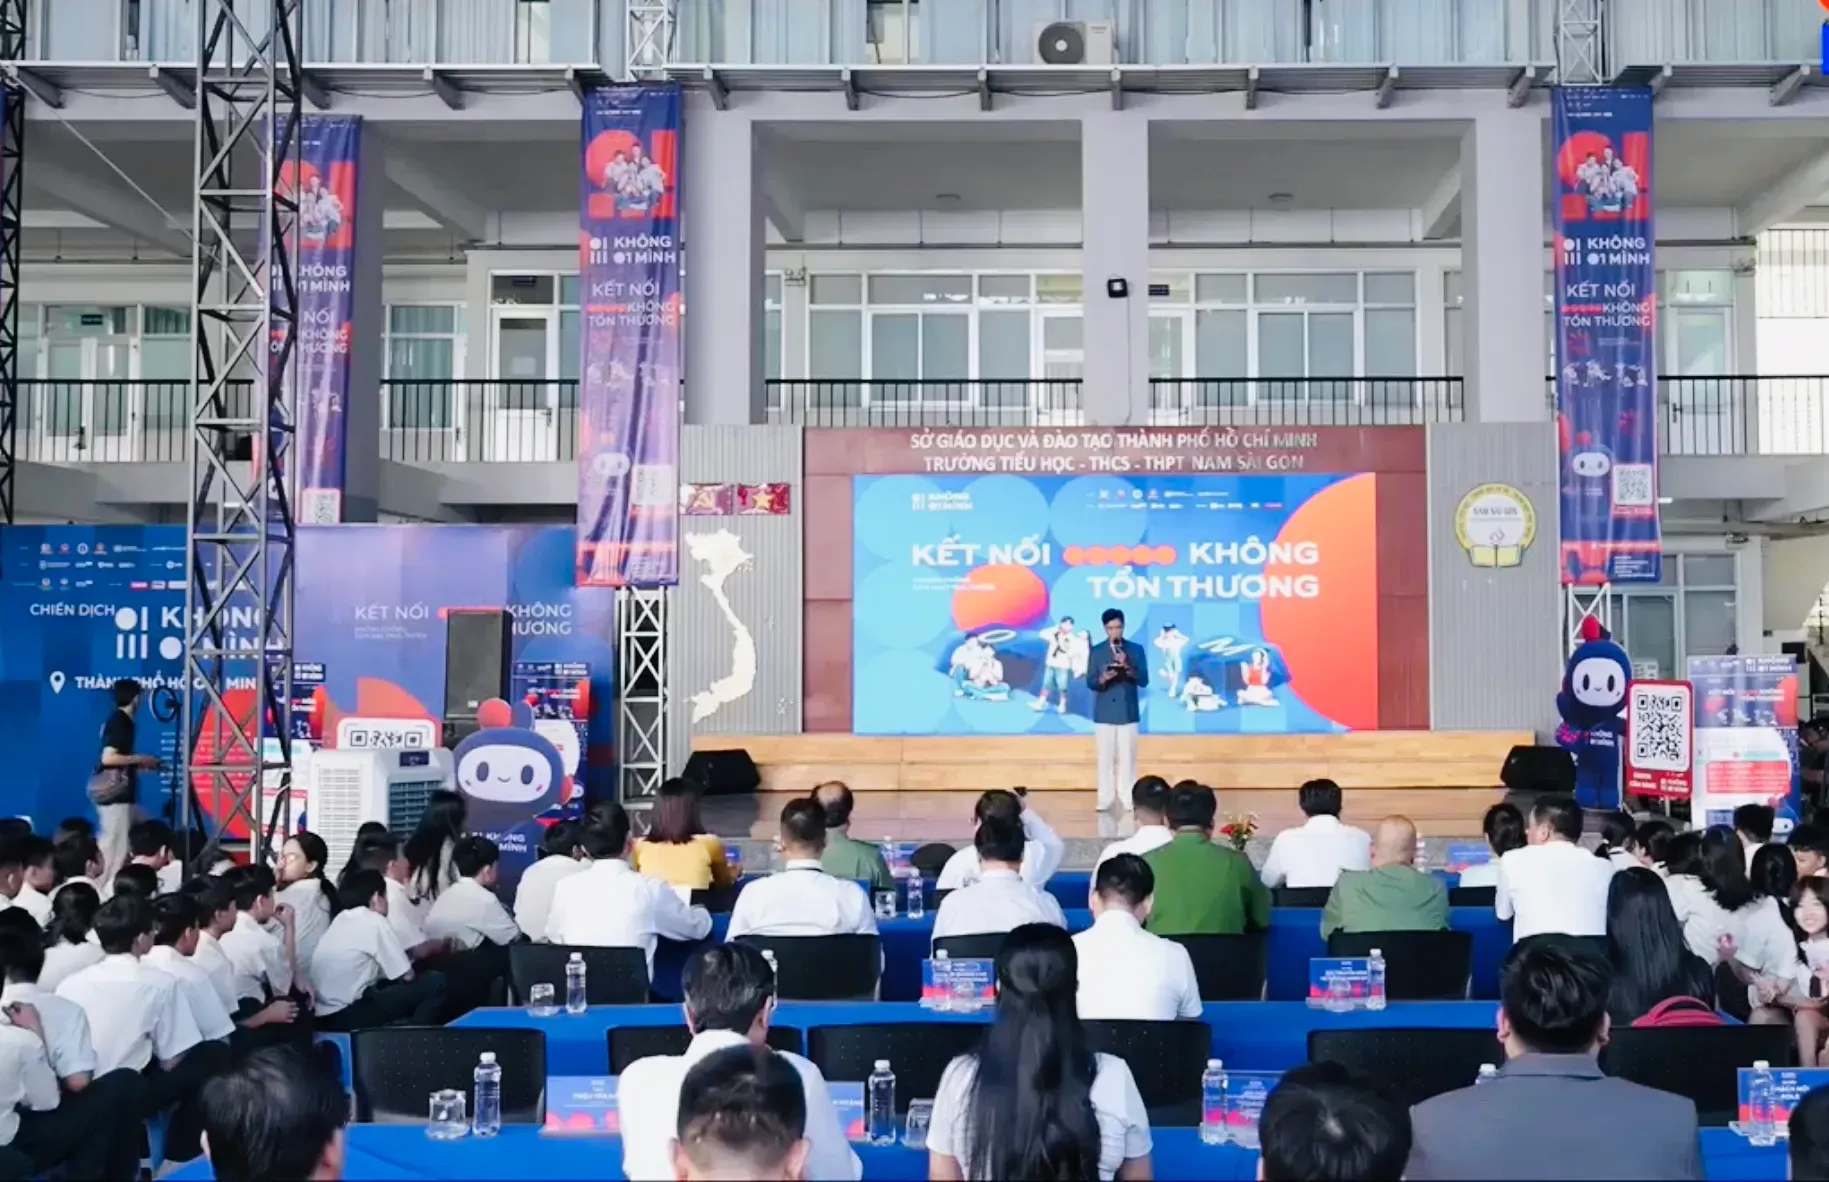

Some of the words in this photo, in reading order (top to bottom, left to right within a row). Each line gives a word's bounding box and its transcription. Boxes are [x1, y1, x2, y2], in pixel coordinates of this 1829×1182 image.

[614, 232, 672, 248] KHÔNG
[1587, 234, 1646, 249] KHÔNG
[634, 250, 676, 263] MÌNH
[1609, 250, 1651, 265] MÌNH
[298, 262, 347, 277] HÔNG
[310, 277, 351, 292] MÌNH
[1566, 280, 1600, 298] KẾT
[1604, 278, 1636, 298] NỐI
[627, 300, 674, 312] KHÔNG
[1602, 300, 1651, 313] KHÔNG
[1594, 315, 1651, 327] THƯƠNG
[910, 428, 933, 449] SỞ
[936, 428, 977, 449] GIÁO
[981, 433, 1014, 452] DỤC
[1017, 428, 1039, 449] VÀ
[1042, 428, 1078, 449] ĐÀO
[1081, 433, 1113, 451] TẠO
[1117, 428, 1173, 449] THÀNH
[1176, 427, 1211, 448] PHỐ
[1214, 427, 1238, 448] HỒ
[1243, 428, 1271, 448] CHÍ
[1273, 432, 1318, 448] MINH
[923, 452, 997, 472] TRƯỜNG
[1040, 456, 1075, 474] HỌC
[1088, 456, 1130, 472] THCS
[1144, 455, 1184, 471] THPT
[1191, 455, 1232, 471] NAM
[913, 533, 981, 566] KẾT
[988, 533, 1050, 566] NỐI
[1190, 535, 1319, 565] KHÔNG
[1166, 573, 1320, 599] THƯƠNG
[79, 603, 115, 618] DỊCH
[355, 602, 390, 620] KẾT
[395, 600, 429, 620] NỐI
[505, 601, 572, 618] KHÔNG
[512, 620, 572, 636] ƯƠNG
